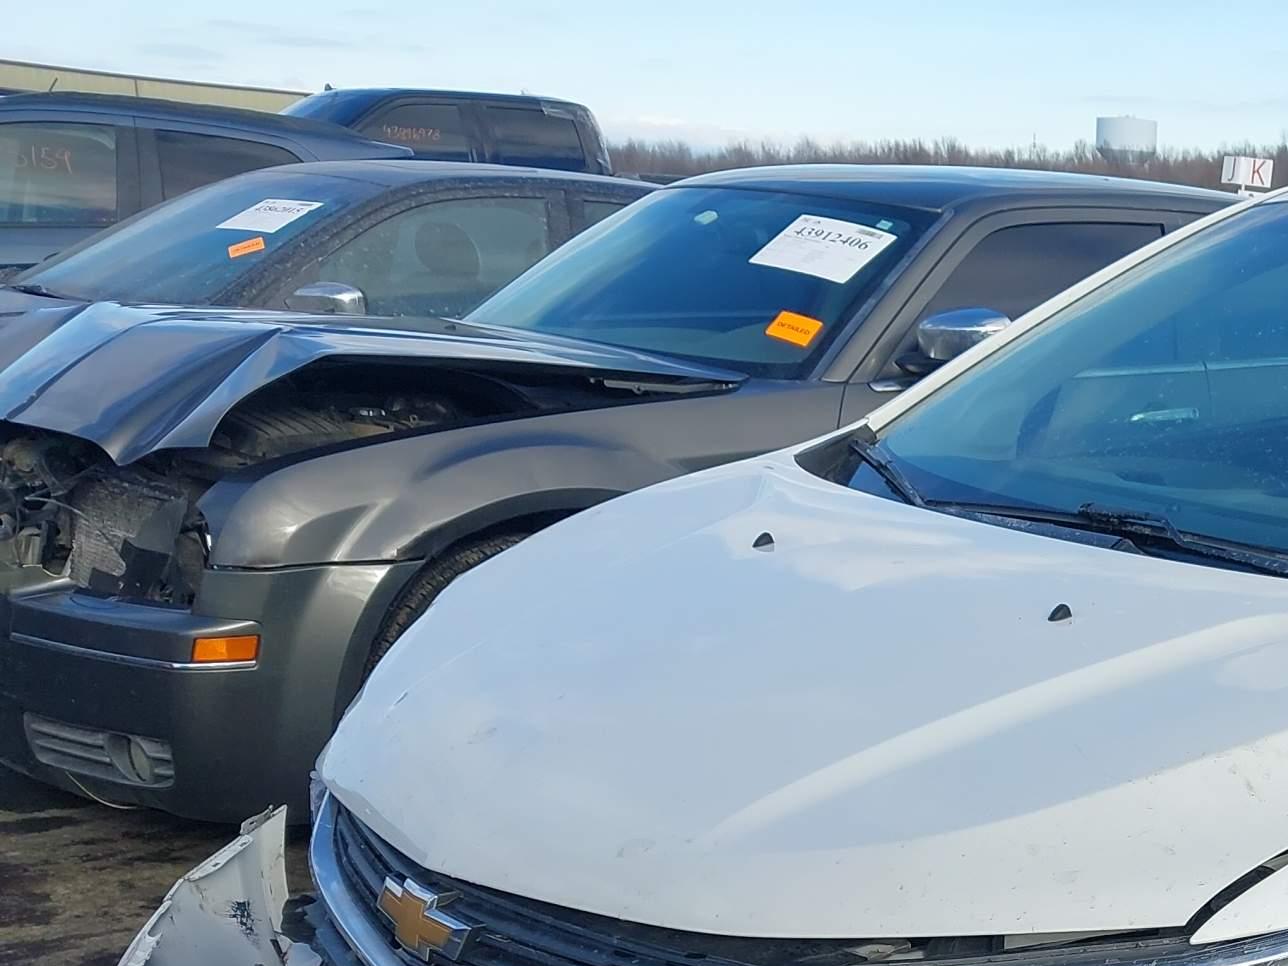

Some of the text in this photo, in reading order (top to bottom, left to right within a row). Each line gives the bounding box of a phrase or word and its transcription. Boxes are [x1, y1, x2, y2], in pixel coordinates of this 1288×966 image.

[1251, 159, 1266, 185] K
[794, 227, 870, 250] 43912406
[776, 321, 811, 335] DETAILED
